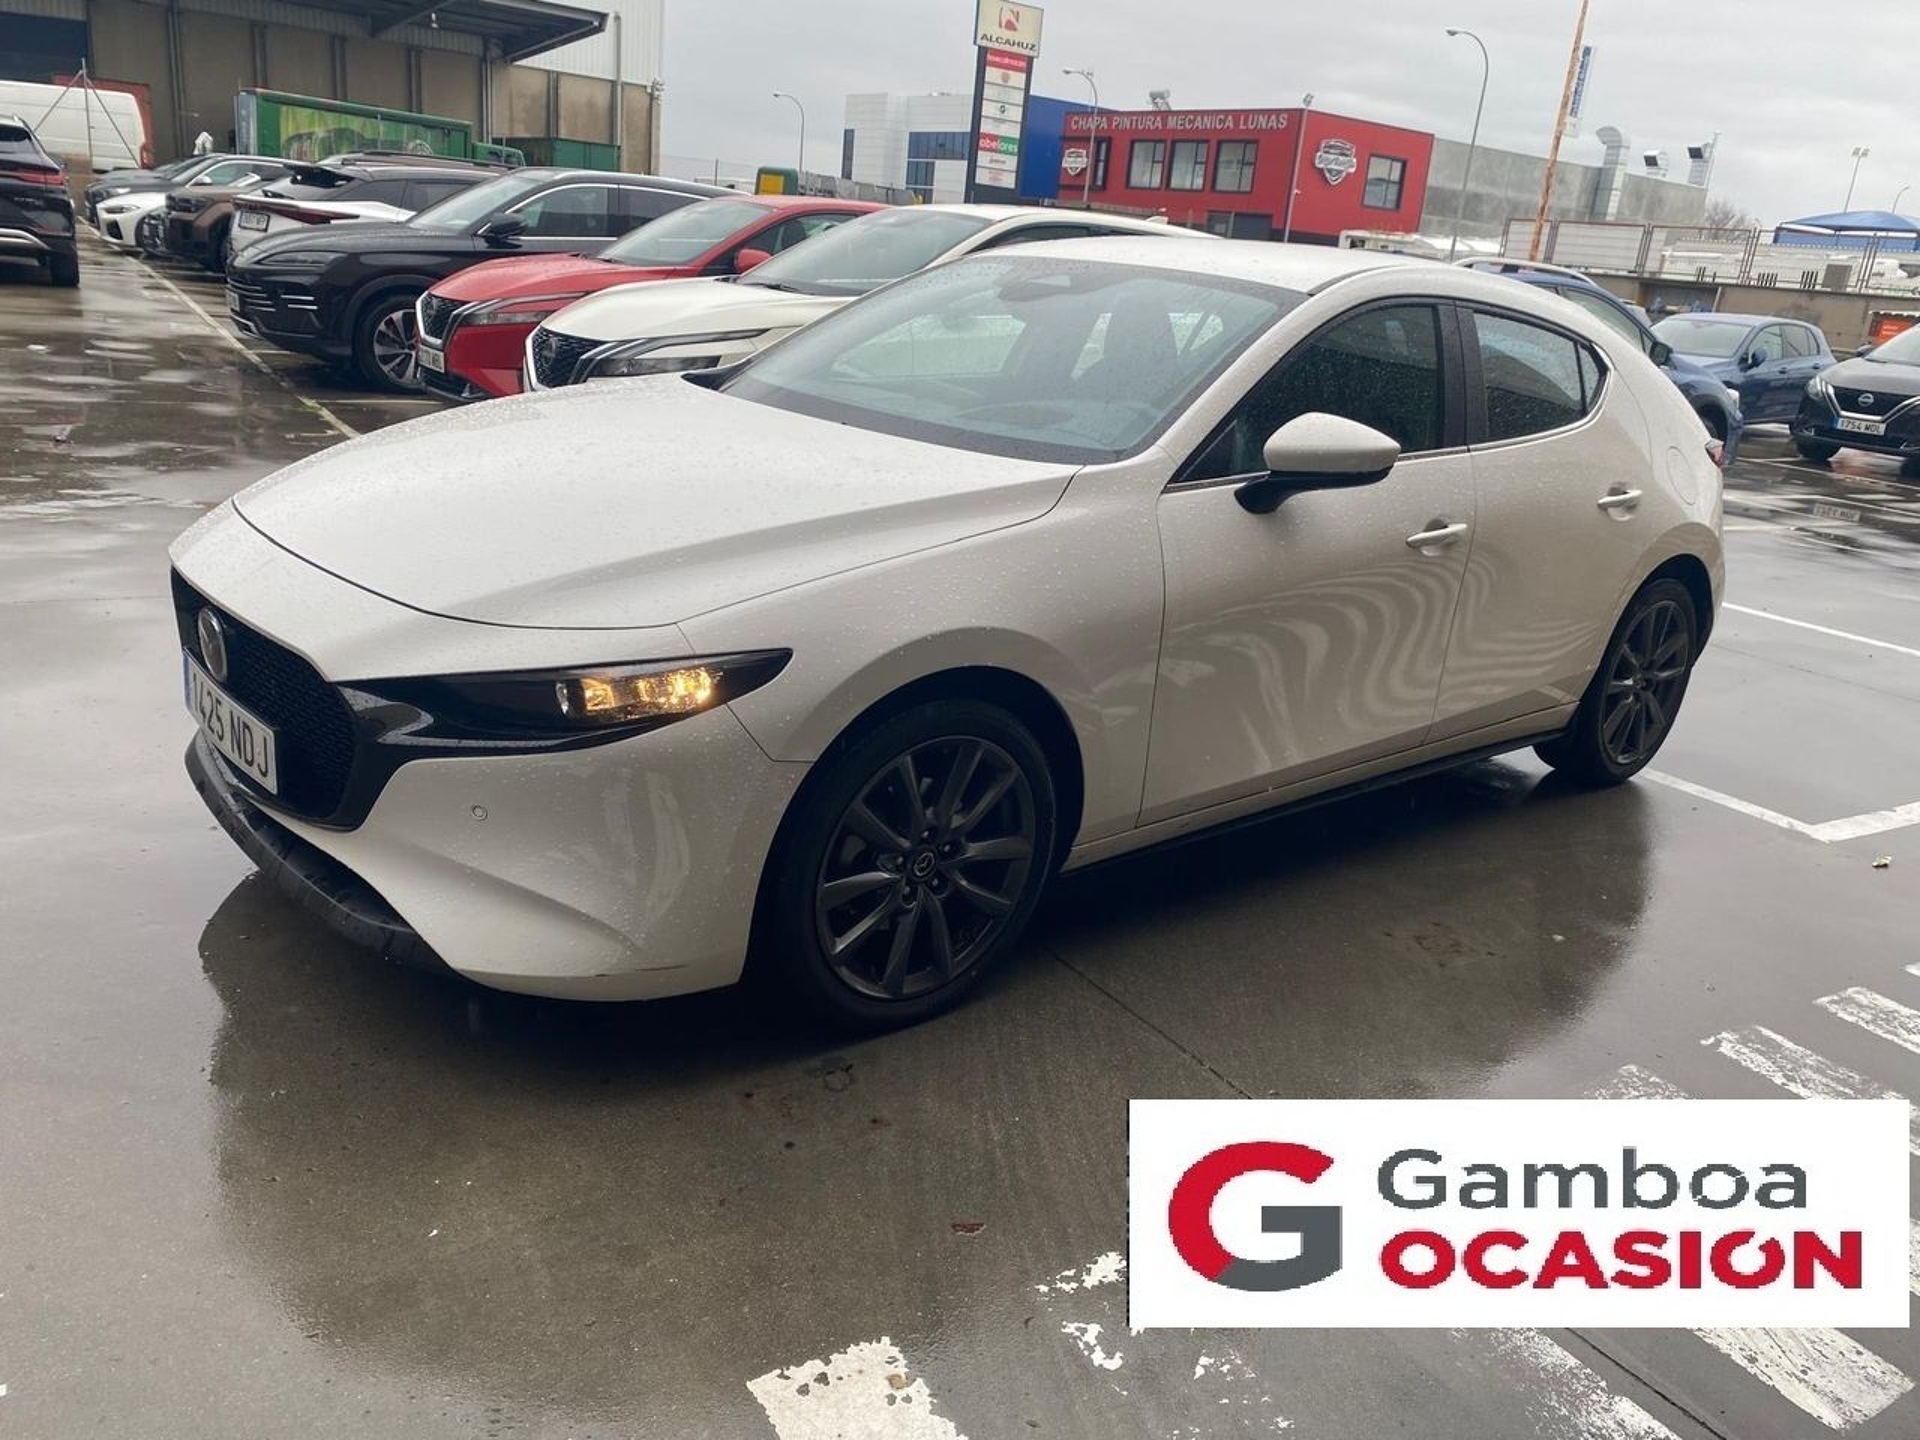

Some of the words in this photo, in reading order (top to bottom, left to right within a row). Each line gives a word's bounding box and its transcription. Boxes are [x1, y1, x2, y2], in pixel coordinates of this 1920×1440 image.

[980, 33, 1037, 52] ALCAHUZ
[1070, 115, 1108, 130] CHAPA
[1112, 115, 1162, 130] PINTURA
[1239, 113, 1288, 130] LUNAS
[230, 710, 268, 778] NDJ
